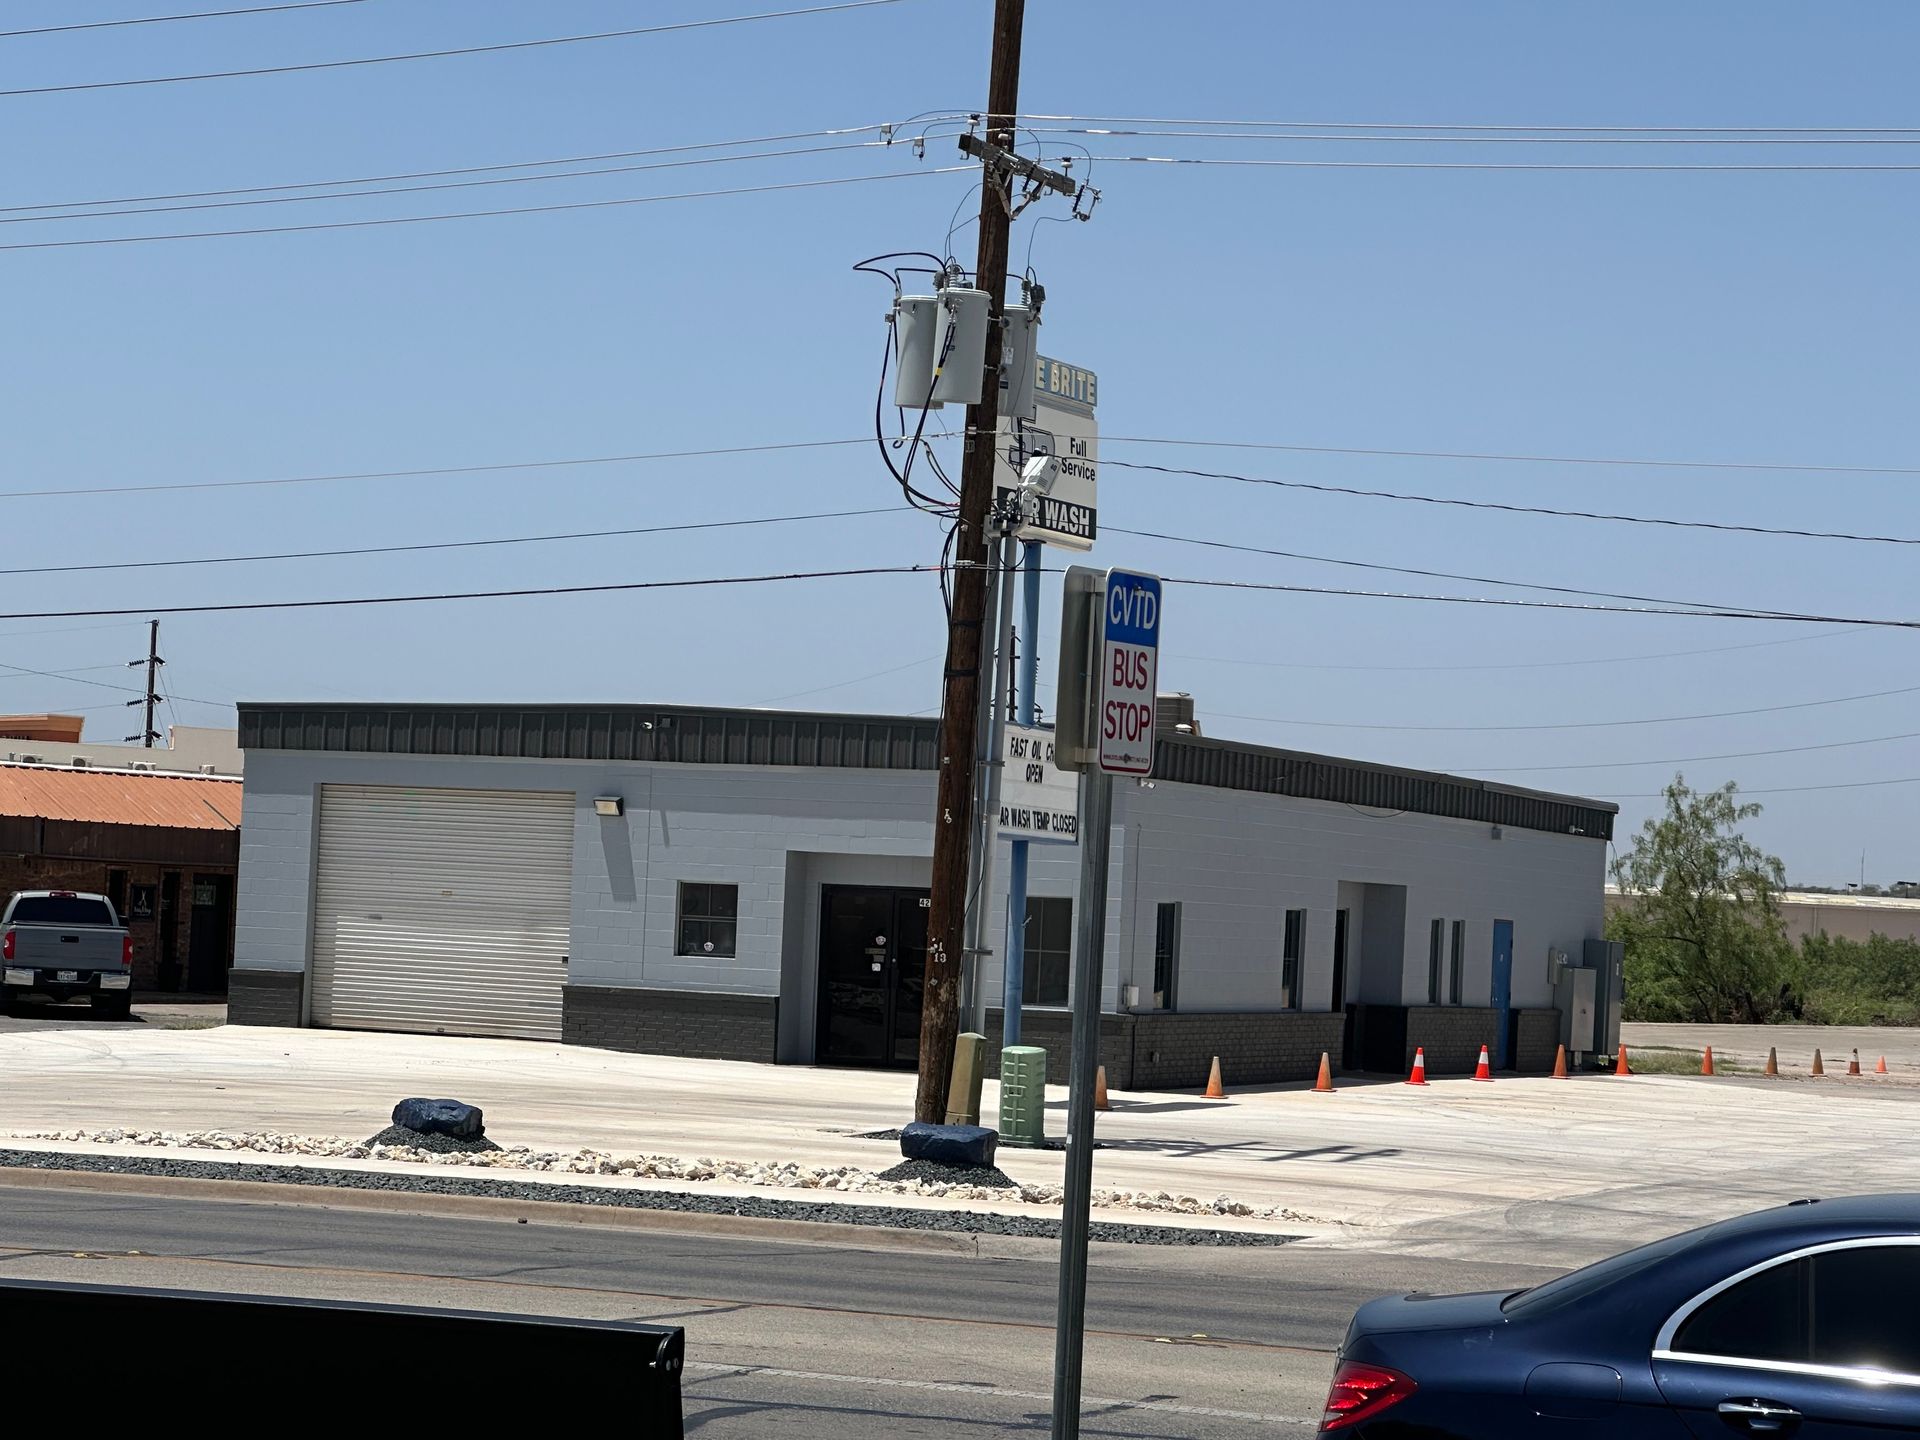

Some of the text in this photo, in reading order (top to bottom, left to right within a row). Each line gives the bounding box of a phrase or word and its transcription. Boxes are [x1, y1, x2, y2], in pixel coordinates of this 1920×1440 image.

[1051, 362, 1096, 403] BRITE
[1070, 436, 1087, 457] Full
[1061, 457, 1096, 481] Service
[1044, 499, 1090, 536] WASH
[1110, 584, 1156, 630] CVTD
[1112, 648, 1148, 691] BUS
[1104, 700, 1151, 742] STOP
[1010, 737, 1029, 758] FAST
[1031, 740, 1042, 760] OIL
[1025, 763, 1044, 783] OPEN
[998, 806, 1077, 833] AR WASH TEMP CLOSED
